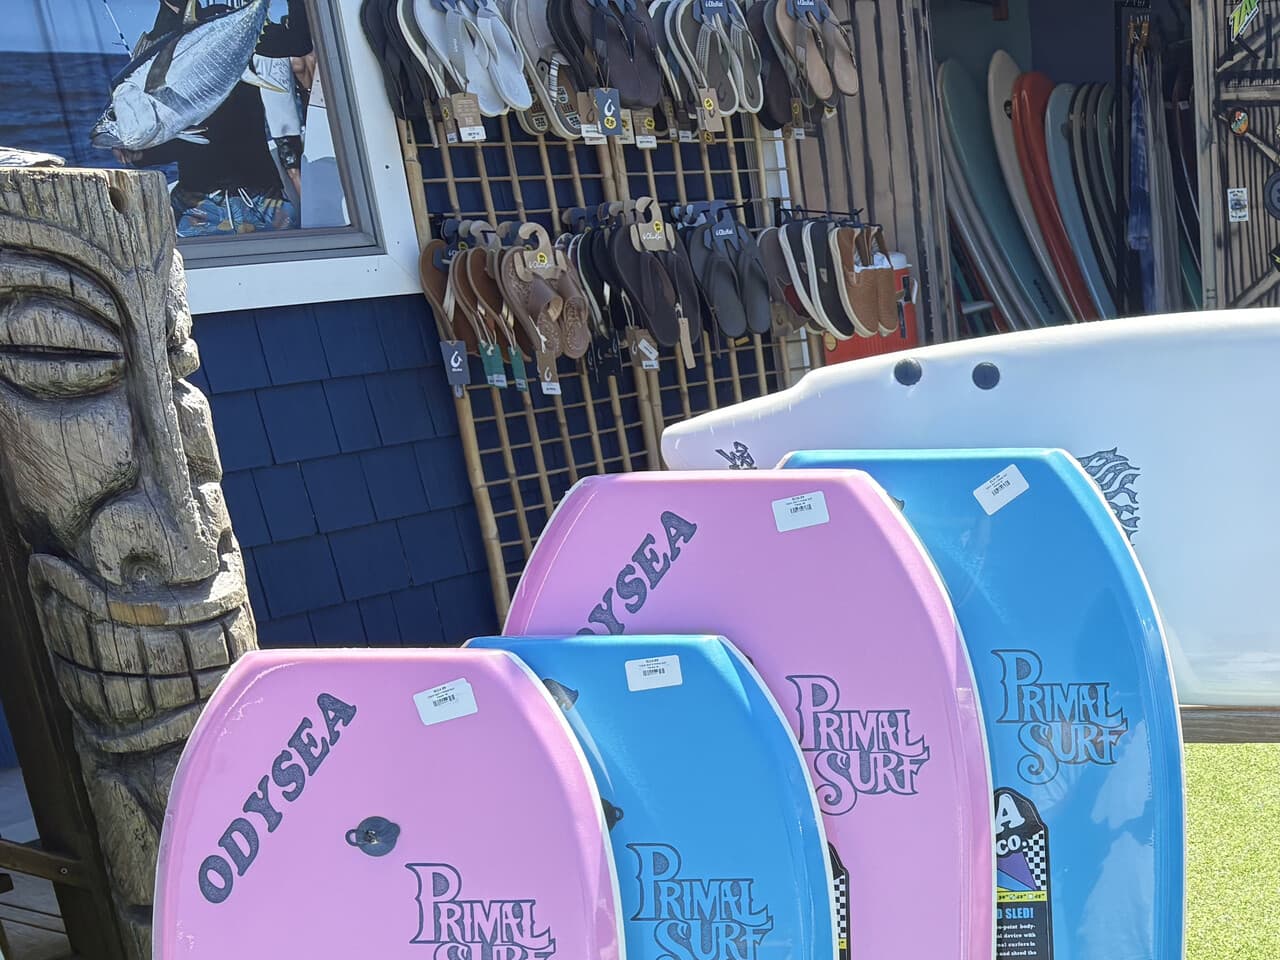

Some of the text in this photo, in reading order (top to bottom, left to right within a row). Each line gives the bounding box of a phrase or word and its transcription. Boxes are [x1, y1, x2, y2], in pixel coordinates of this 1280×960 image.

[576, 510, 698, 635] YSEA
[785, 675, 928, 757] PRIMAL
[990, 649, 1127, 728] PRIMAL
[813, 748, 930, 816] SURF
[1017, 719, 1128, 784] SURF
[198, 692, 357, 903] ODYSEA
[404, 863, 555, 953] PRIMAL
[625, 843, 774, 927] PRIMAL
[1005, 908, 1034, 919] SLED!
